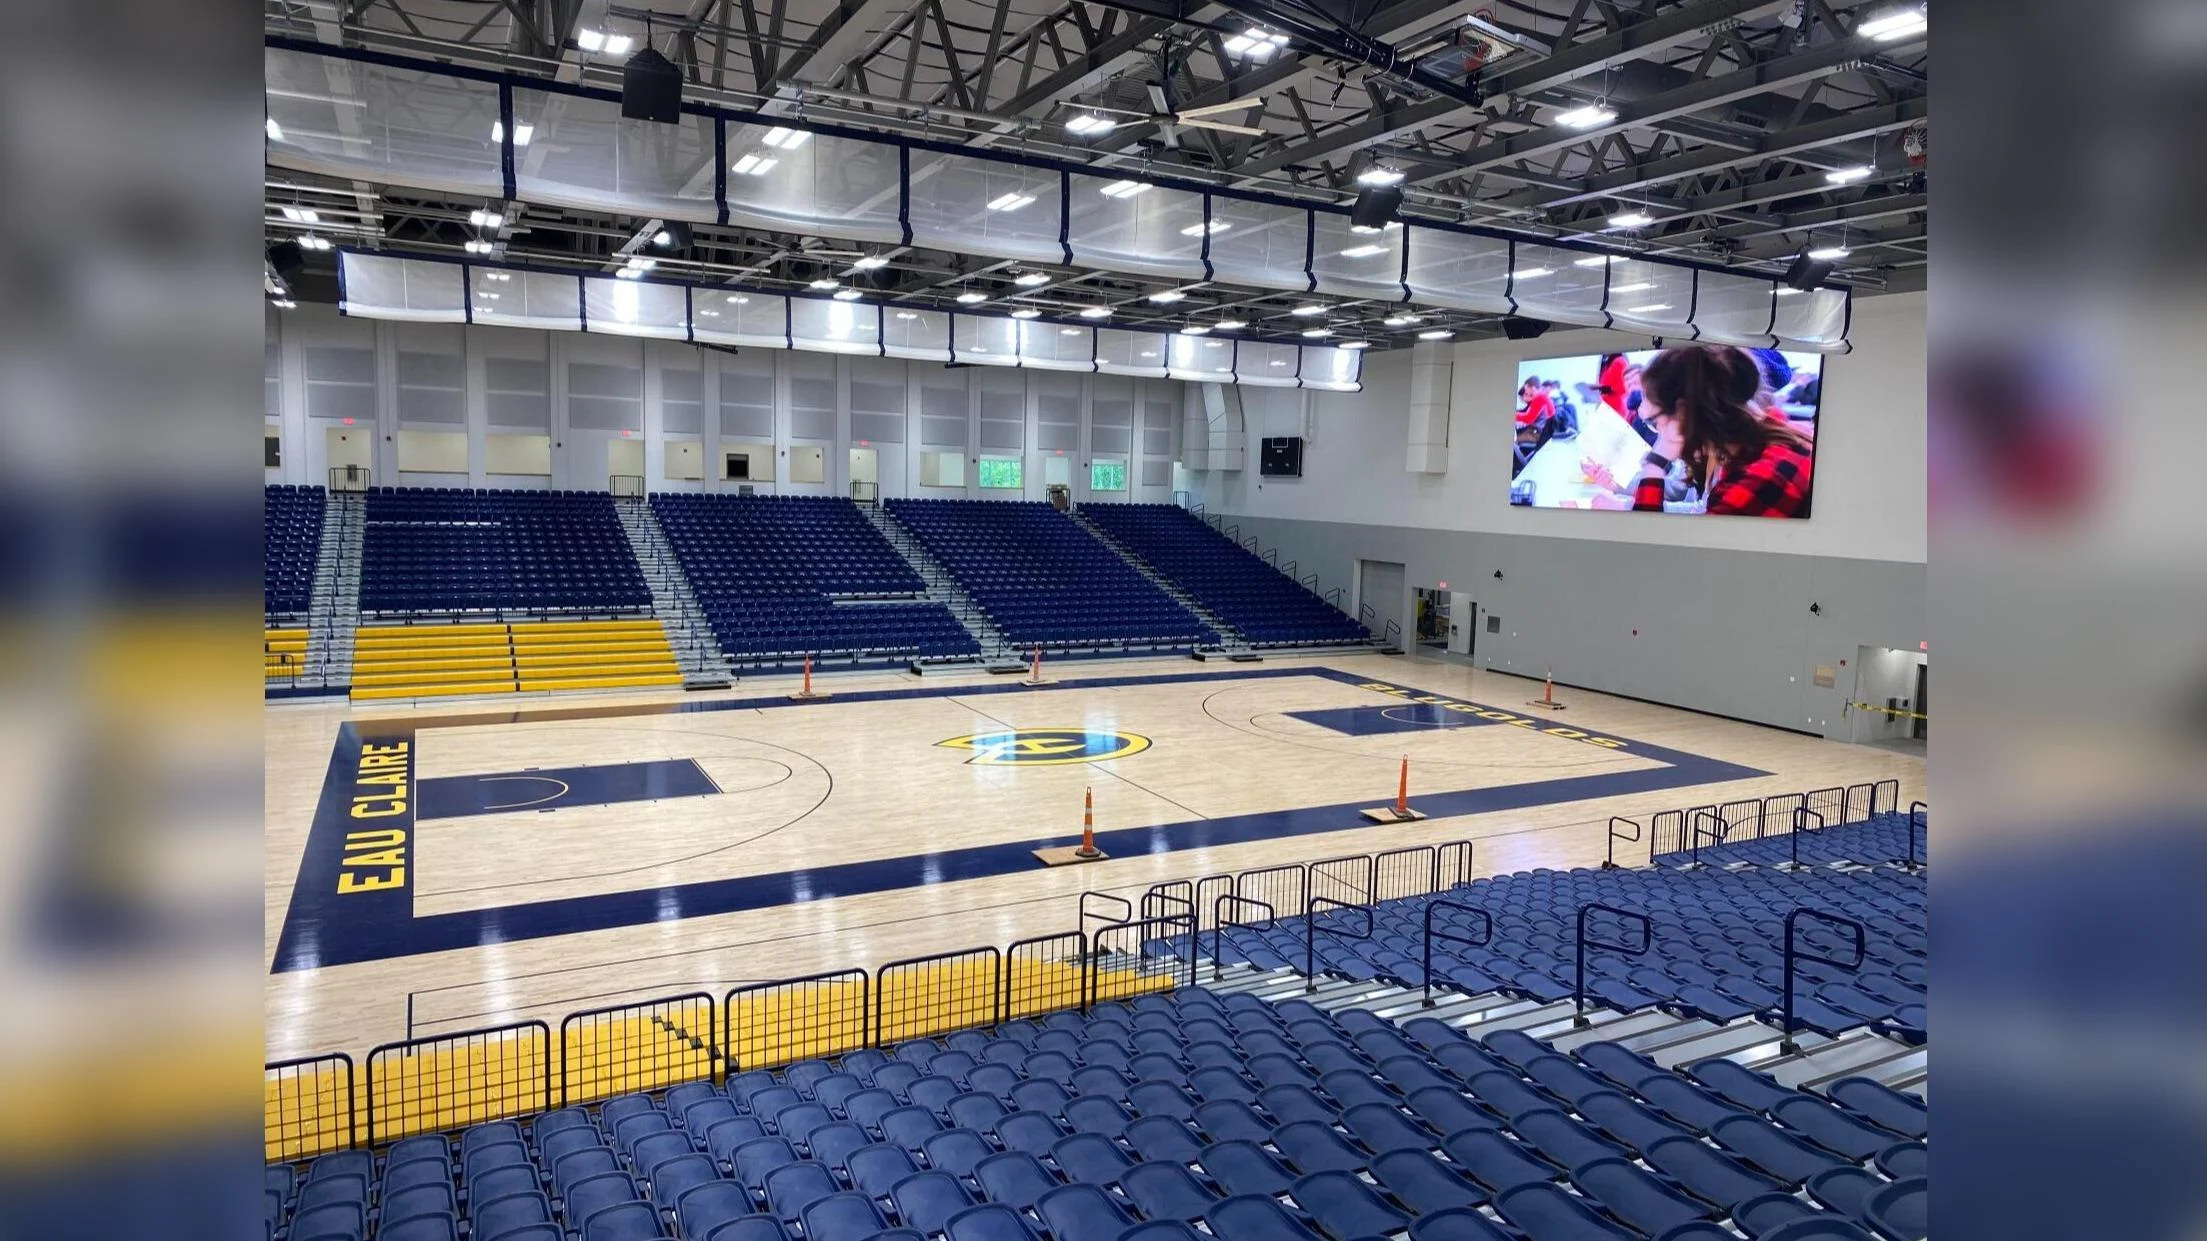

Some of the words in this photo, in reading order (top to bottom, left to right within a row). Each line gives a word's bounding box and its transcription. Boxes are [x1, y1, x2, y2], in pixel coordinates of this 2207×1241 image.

[1359, 682, 1629, 749] BLUGOLDS
[350, 741, 408, 819] CLAIRE
[336, 829, 406, 895] EAU
